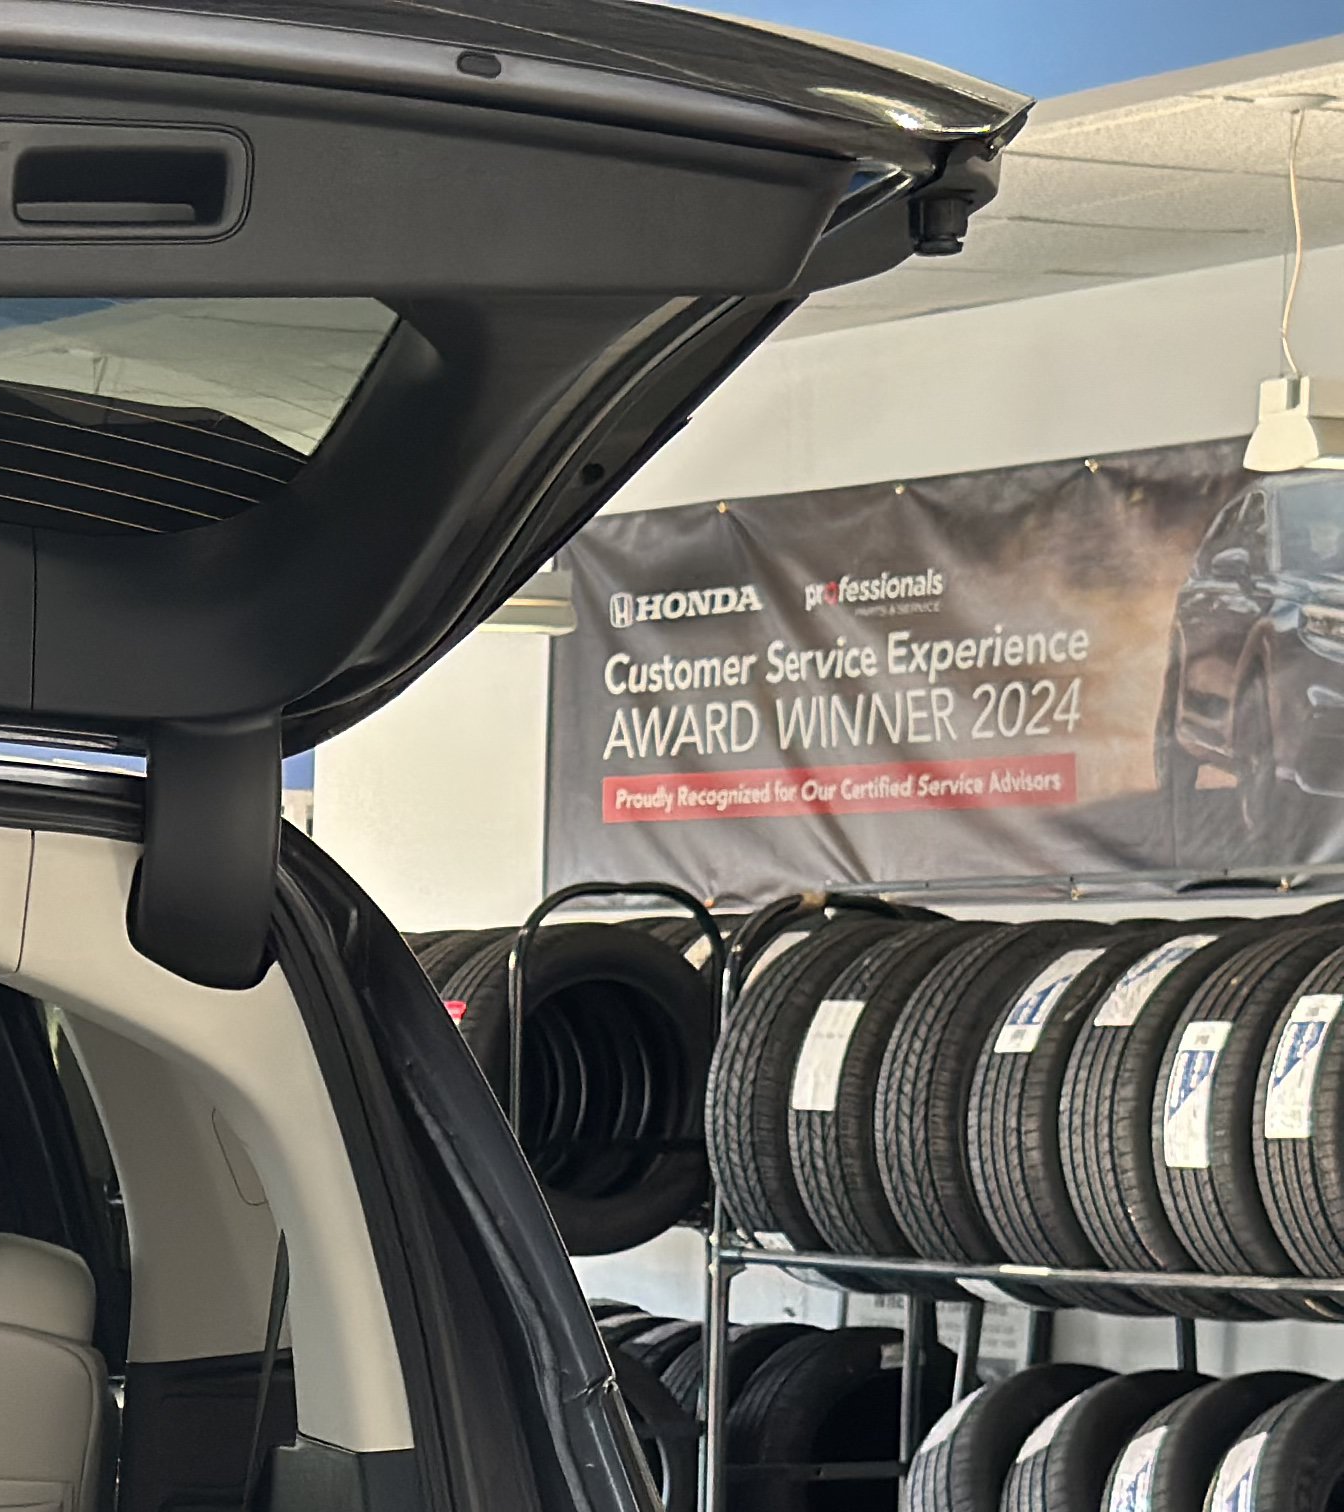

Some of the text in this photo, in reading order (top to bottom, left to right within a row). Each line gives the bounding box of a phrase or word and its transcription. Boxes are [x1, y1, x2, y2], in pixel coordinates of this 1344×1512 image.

[635, 585, 762, 622] HONDA
[805, 568, 944, 611] professionals
[604, 624, 1090, 695] Customer Service Experience
[602, 677, 1082, 760] AWARD WINNER 2024
[615, 768, 1062, 814] Proudly Recognized for Our Certified Service Advisors
